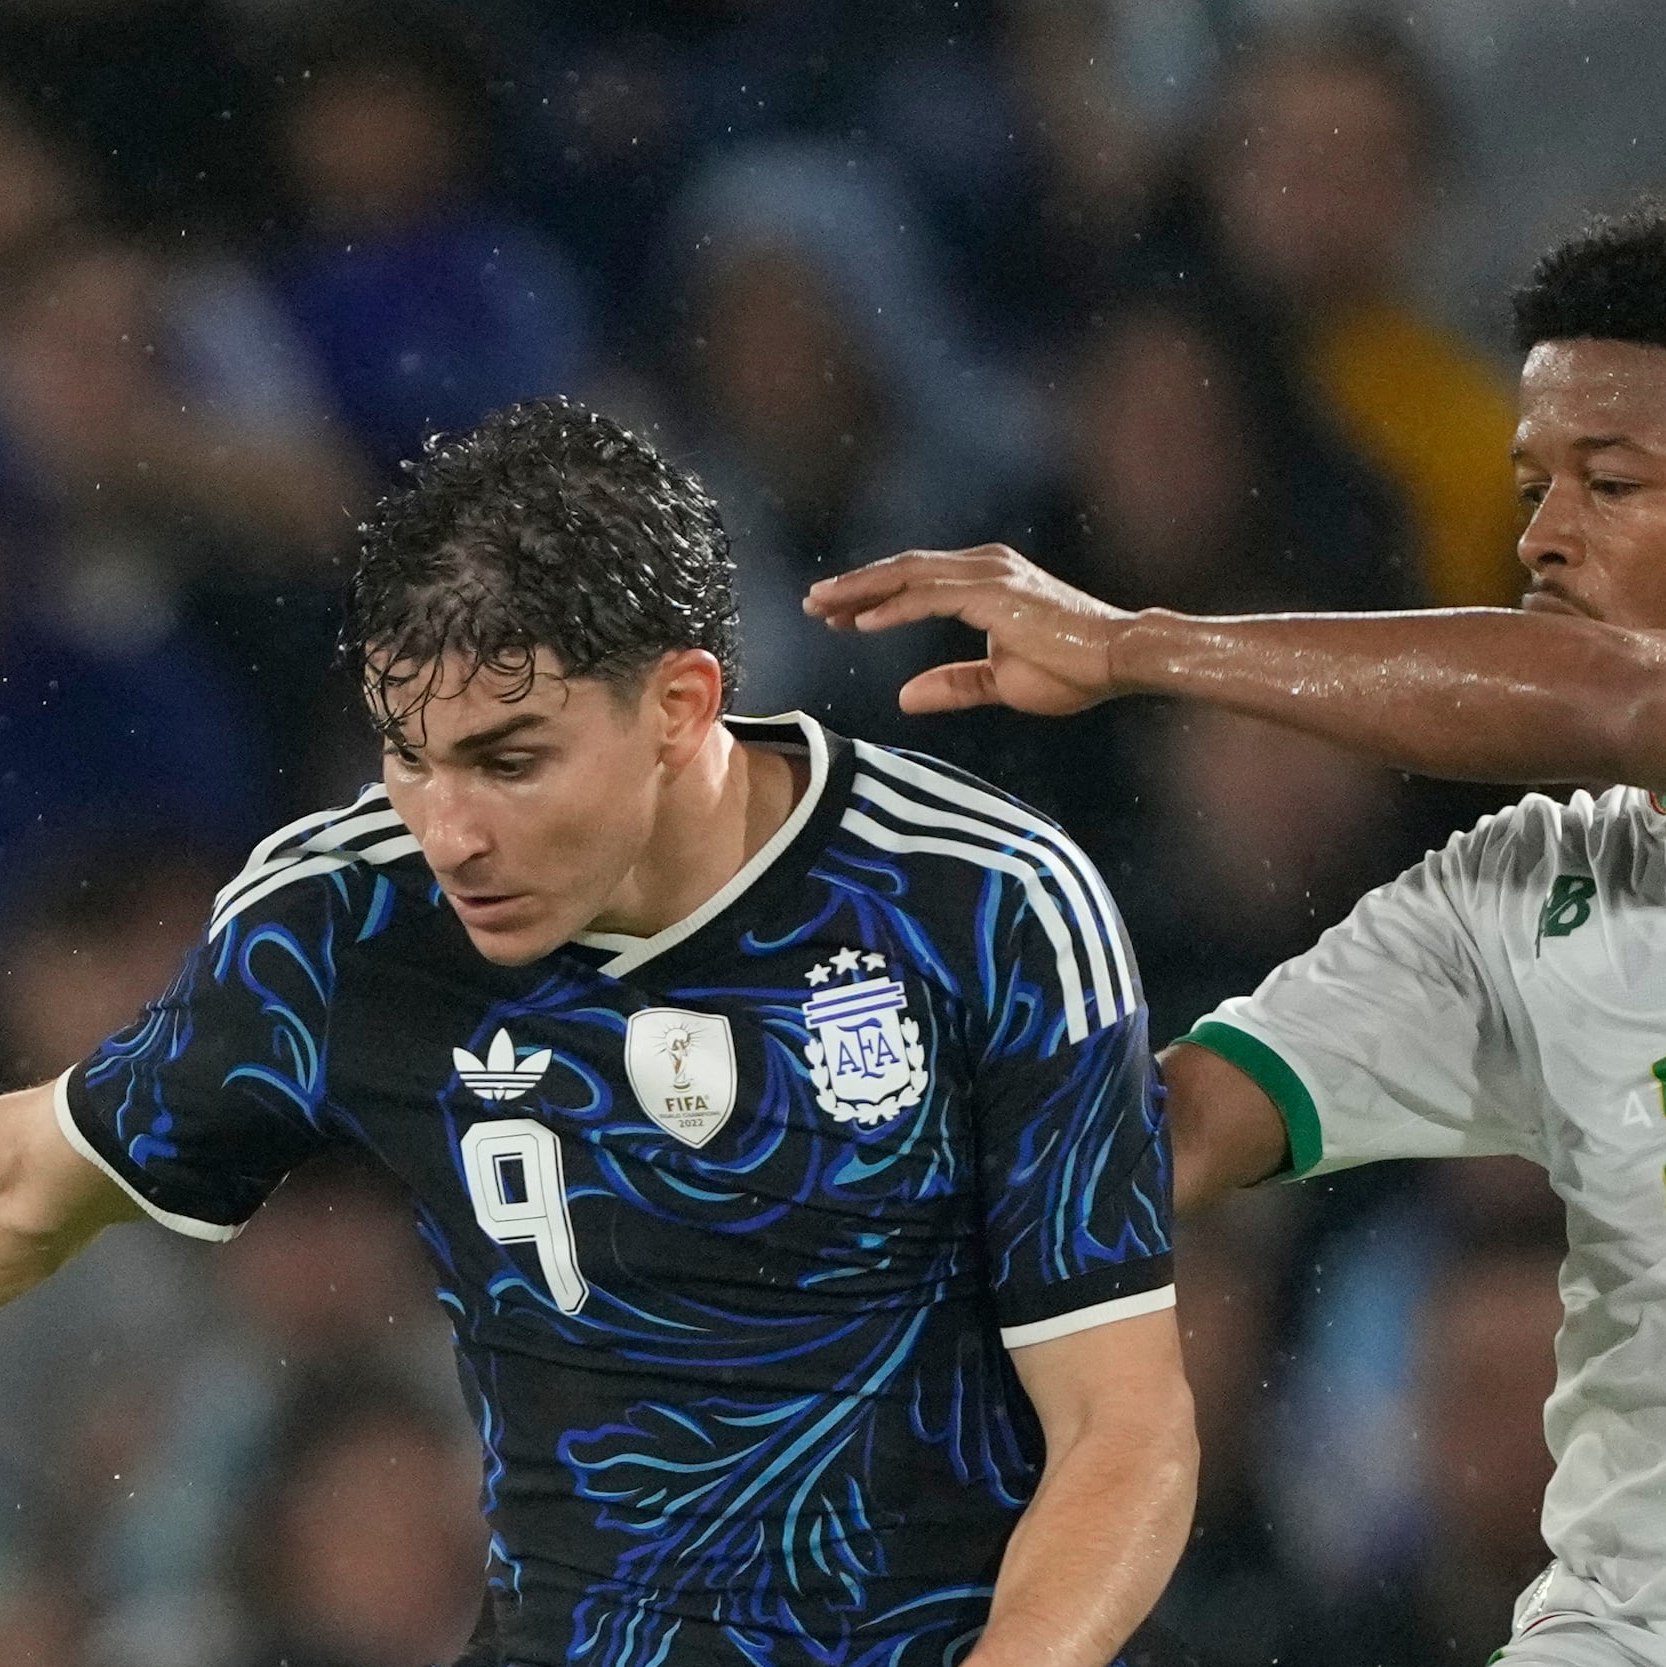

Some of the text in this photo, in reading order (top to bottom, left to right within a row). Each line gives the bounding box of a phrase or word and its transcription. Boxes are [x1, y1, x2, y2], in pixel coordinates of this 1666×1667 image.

[837, 1017, 900, 1079] AFA
[664, 1095, 709, 1111] FIFA
[678, 1119, 704, 1128] 2022
[461, 1119, 590, 1315] 9
